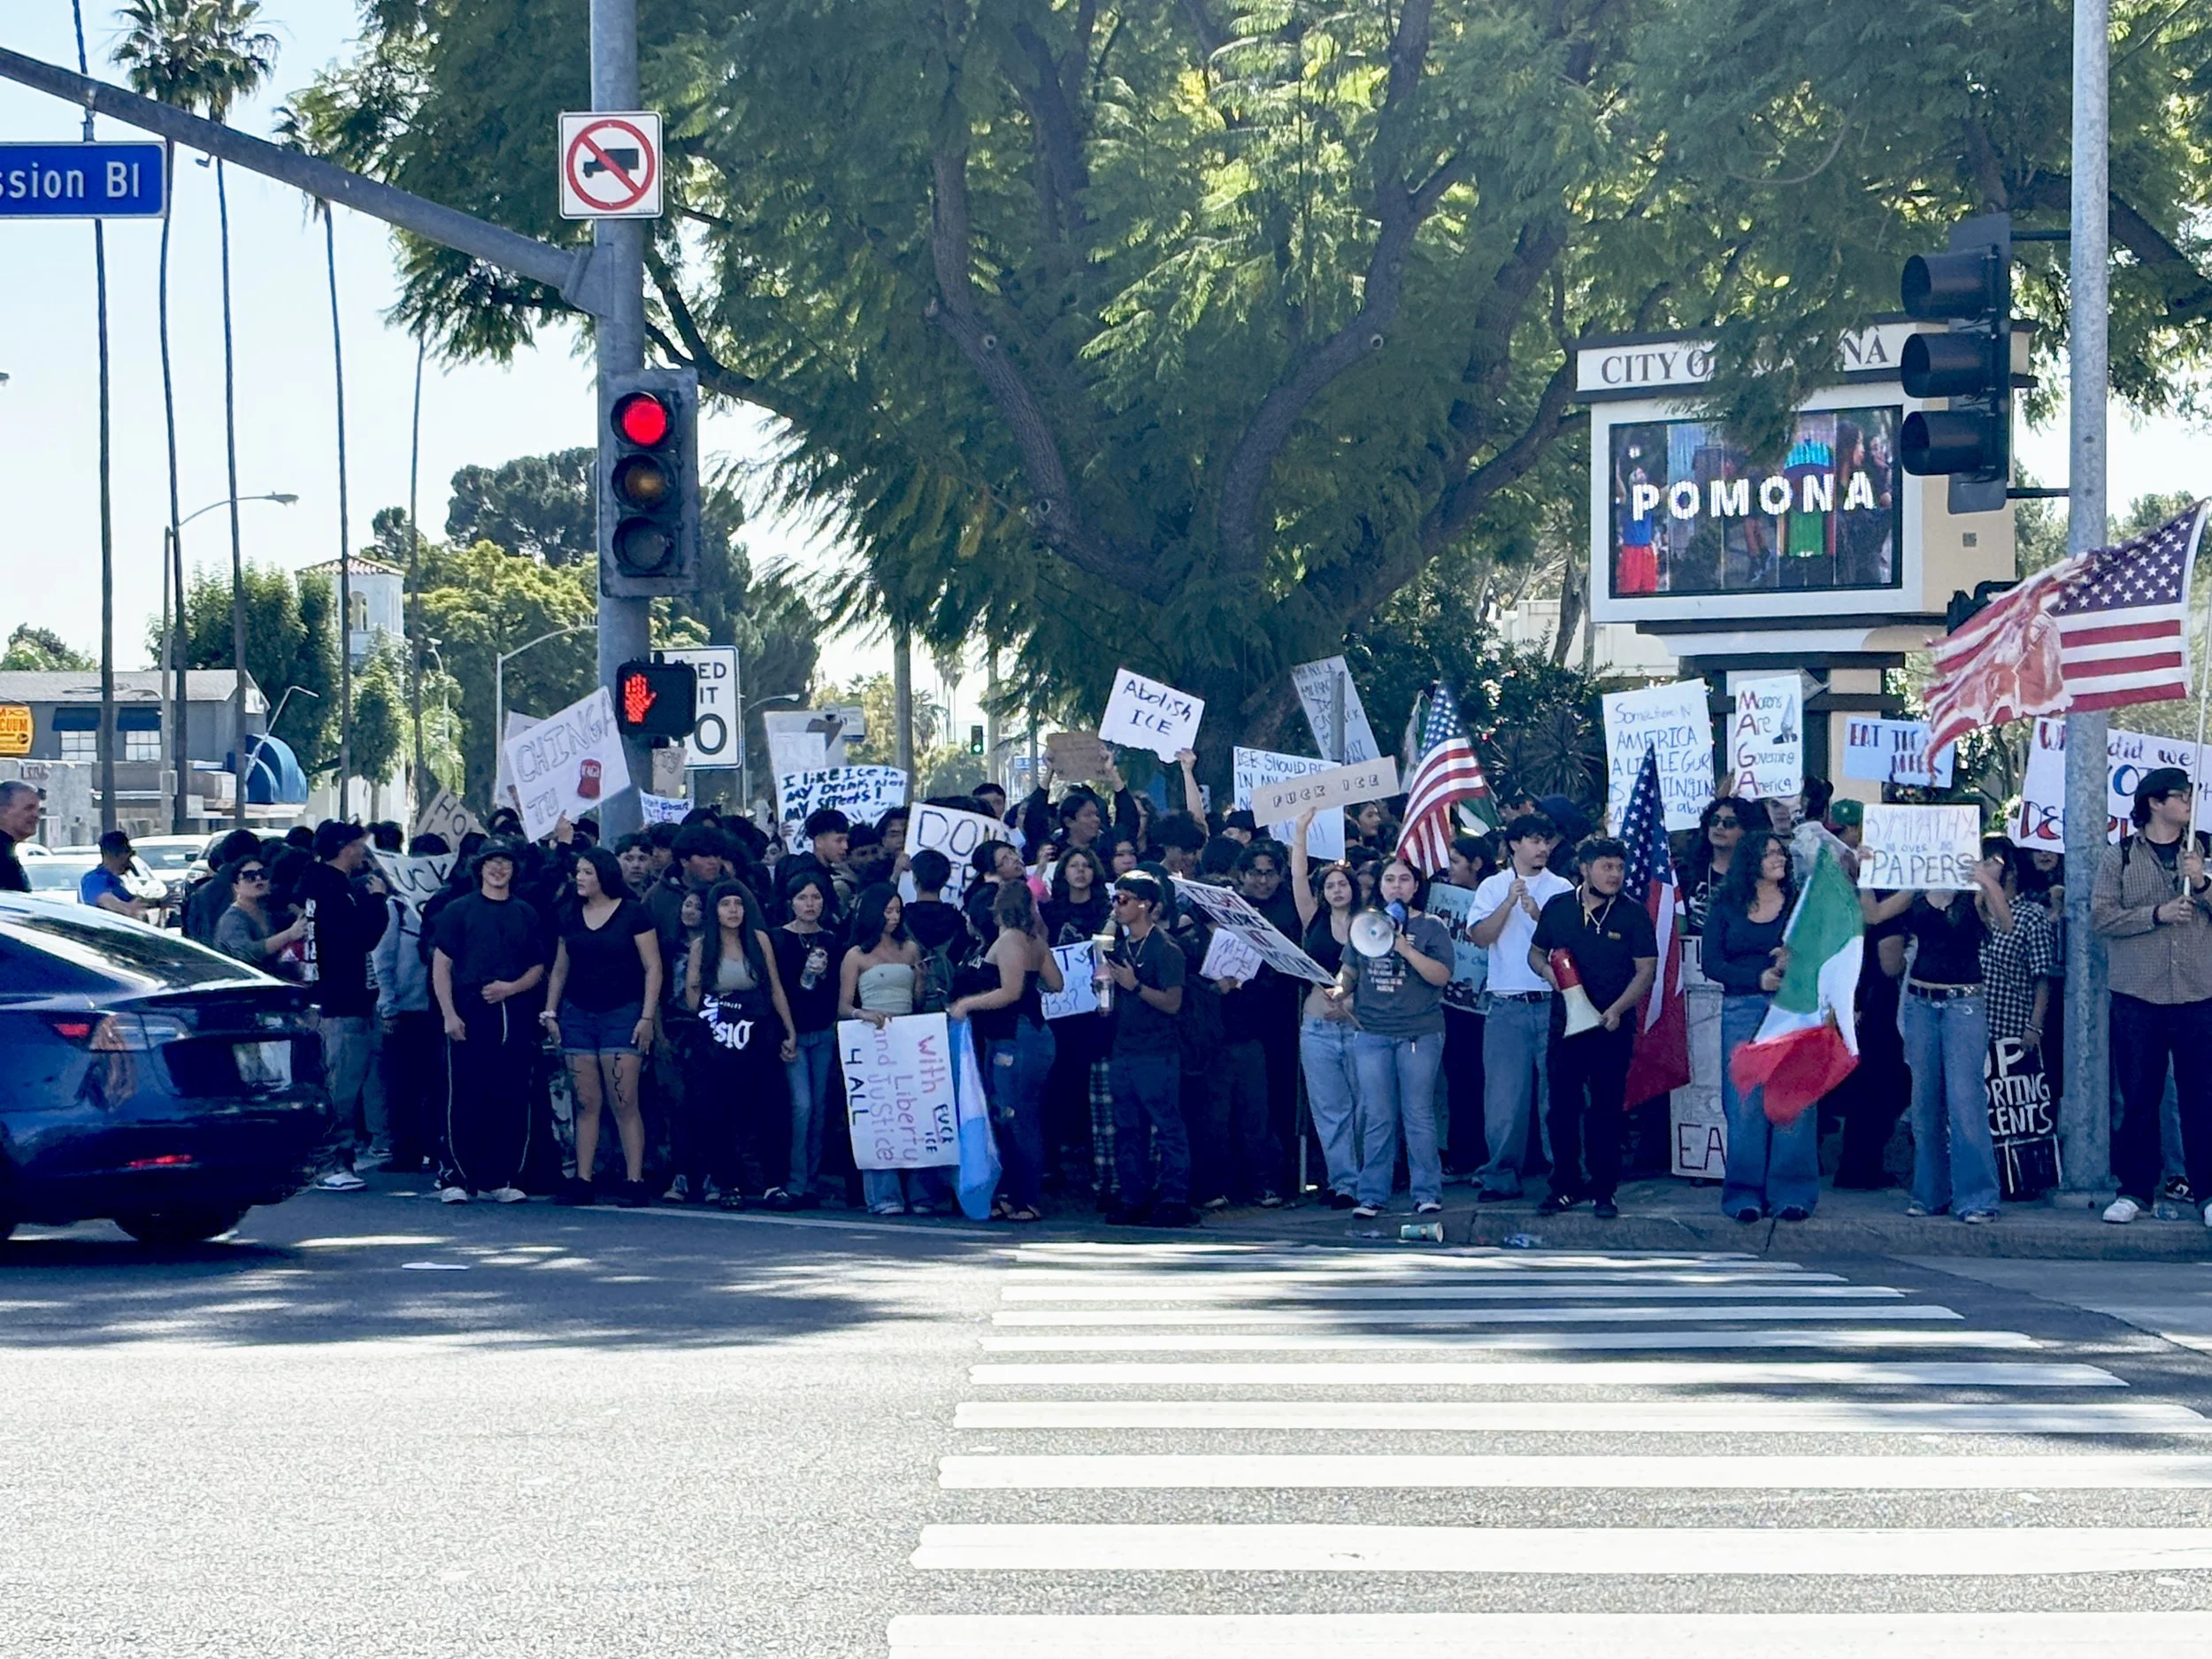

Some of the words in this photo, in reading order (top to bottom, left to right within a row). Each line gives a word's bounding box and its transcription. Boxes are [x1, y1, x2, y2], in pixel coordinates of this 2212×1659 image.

[0, 162, 84, 198] sion
[1601, 351, 1678, 384] CITY
[1686, 349, 1709, 378] O
[1632, 472, 1876, 520] POMONA
[0, 718, 27, 732] CUUM
[694, 713, 727, 755] 0
[1130, 710, 1173, 736] ICE
[1617, 726, 1698, 752] AMERICA
[1736, 714, 1772, 736] Are
[1850, 724, 1883, 747] EAT
[1264, 754, 1306, 775] SHOULD
[2108, 736, 2142, 758] did
[2158, 749, 2193, 766] we
[1273, 785, 1325, 807] FUCK
[1342, 774, 1379, 791] ICE
[395, 858, 449, 893] UCK
[1870, 849, 1975, 886] PAPERS
[845, 1048, 863, 1065] 4
[848, 1076, 870, 1126] ALL
[1985, 1071, 2051, 1108] RTING
[933, 1104, 955, 1144] FUCK
[1987, 1101, 2053, 1137] CENTS
[925, 1132, 938, 1154] ICE
